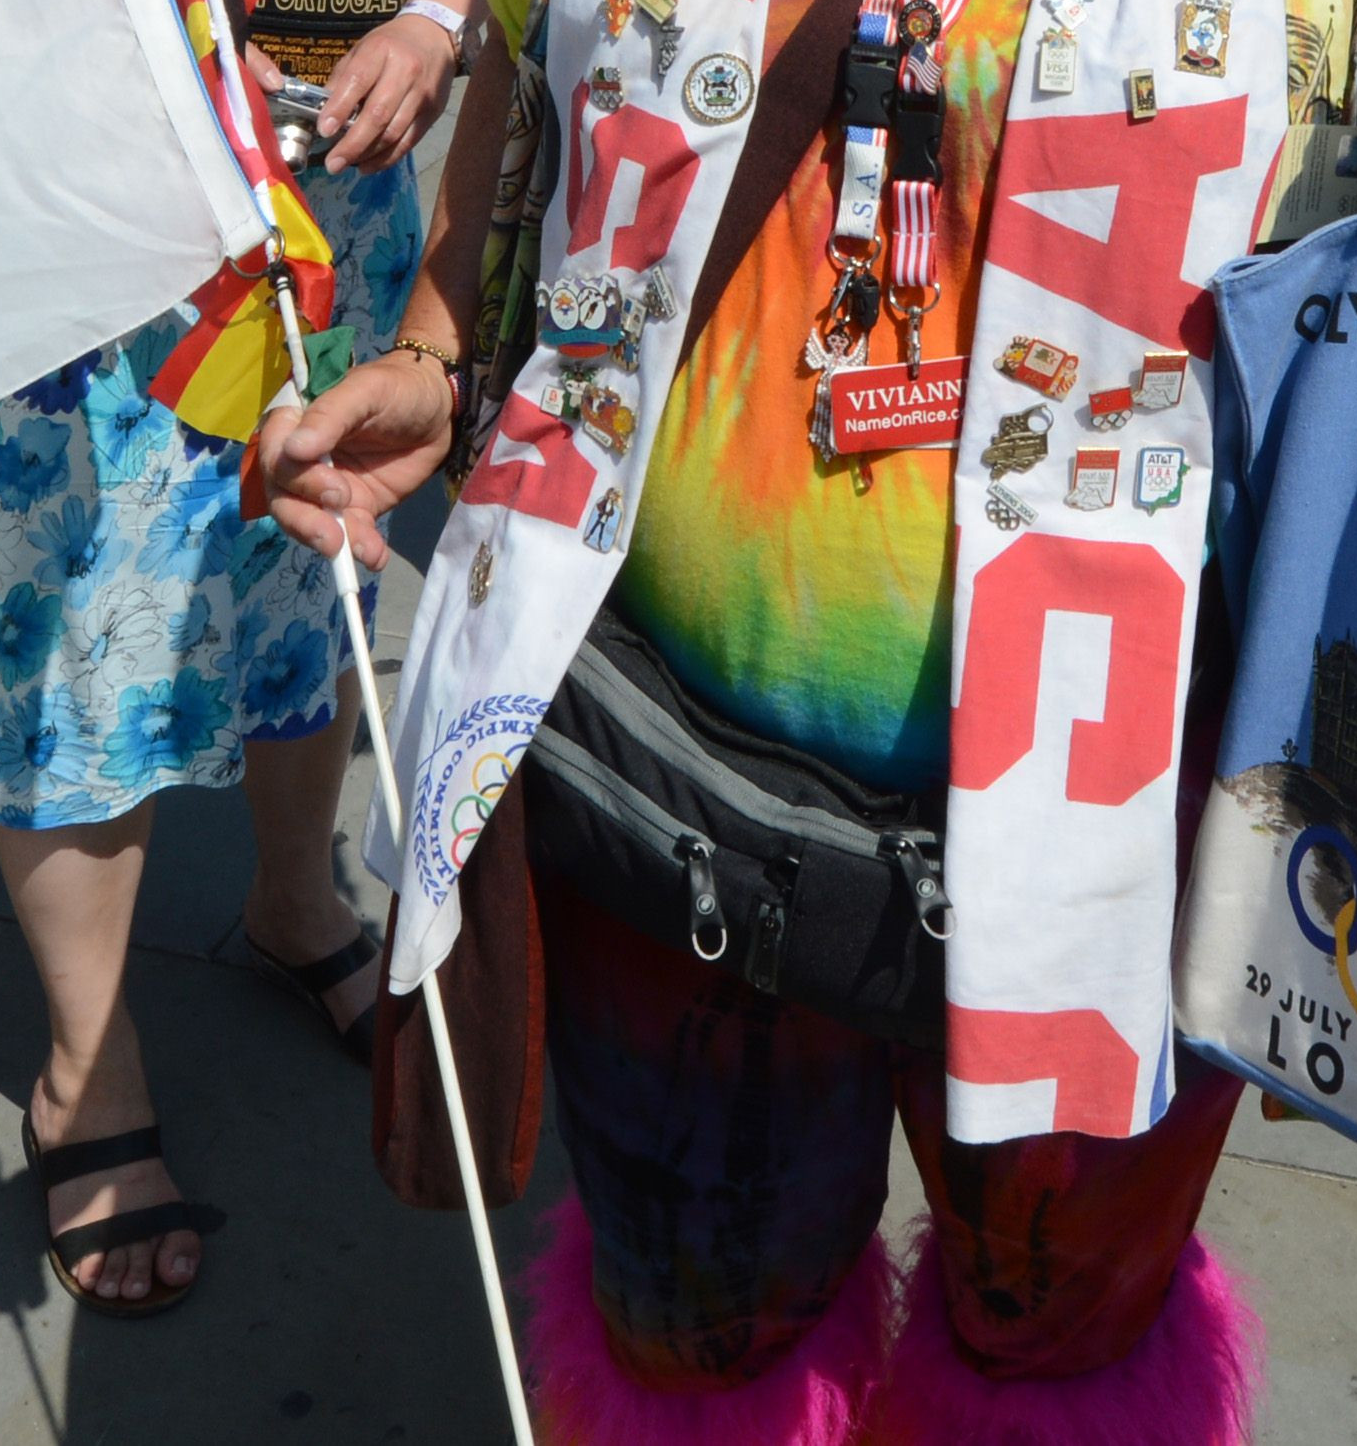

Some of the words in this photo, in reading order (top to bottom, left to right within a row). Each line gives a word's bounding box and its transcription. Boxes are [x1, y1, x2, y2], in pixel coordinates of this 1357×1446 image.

[263, 43, 306, 54] PORTUGAL
[846, 378, 967, 412] VIVIANN
[1147, 454, 1174, 465] AT&T
[1148, 468, 1171, 477] USA
[991, 483, 1020, 508] ATHENS
[467, 719, 544, 750] YMPIC
[428, 749, 463, 886] COMMITT
[1245, 962, 1274, 997] 29
[1279, 988, 1352, 1044] JULY
